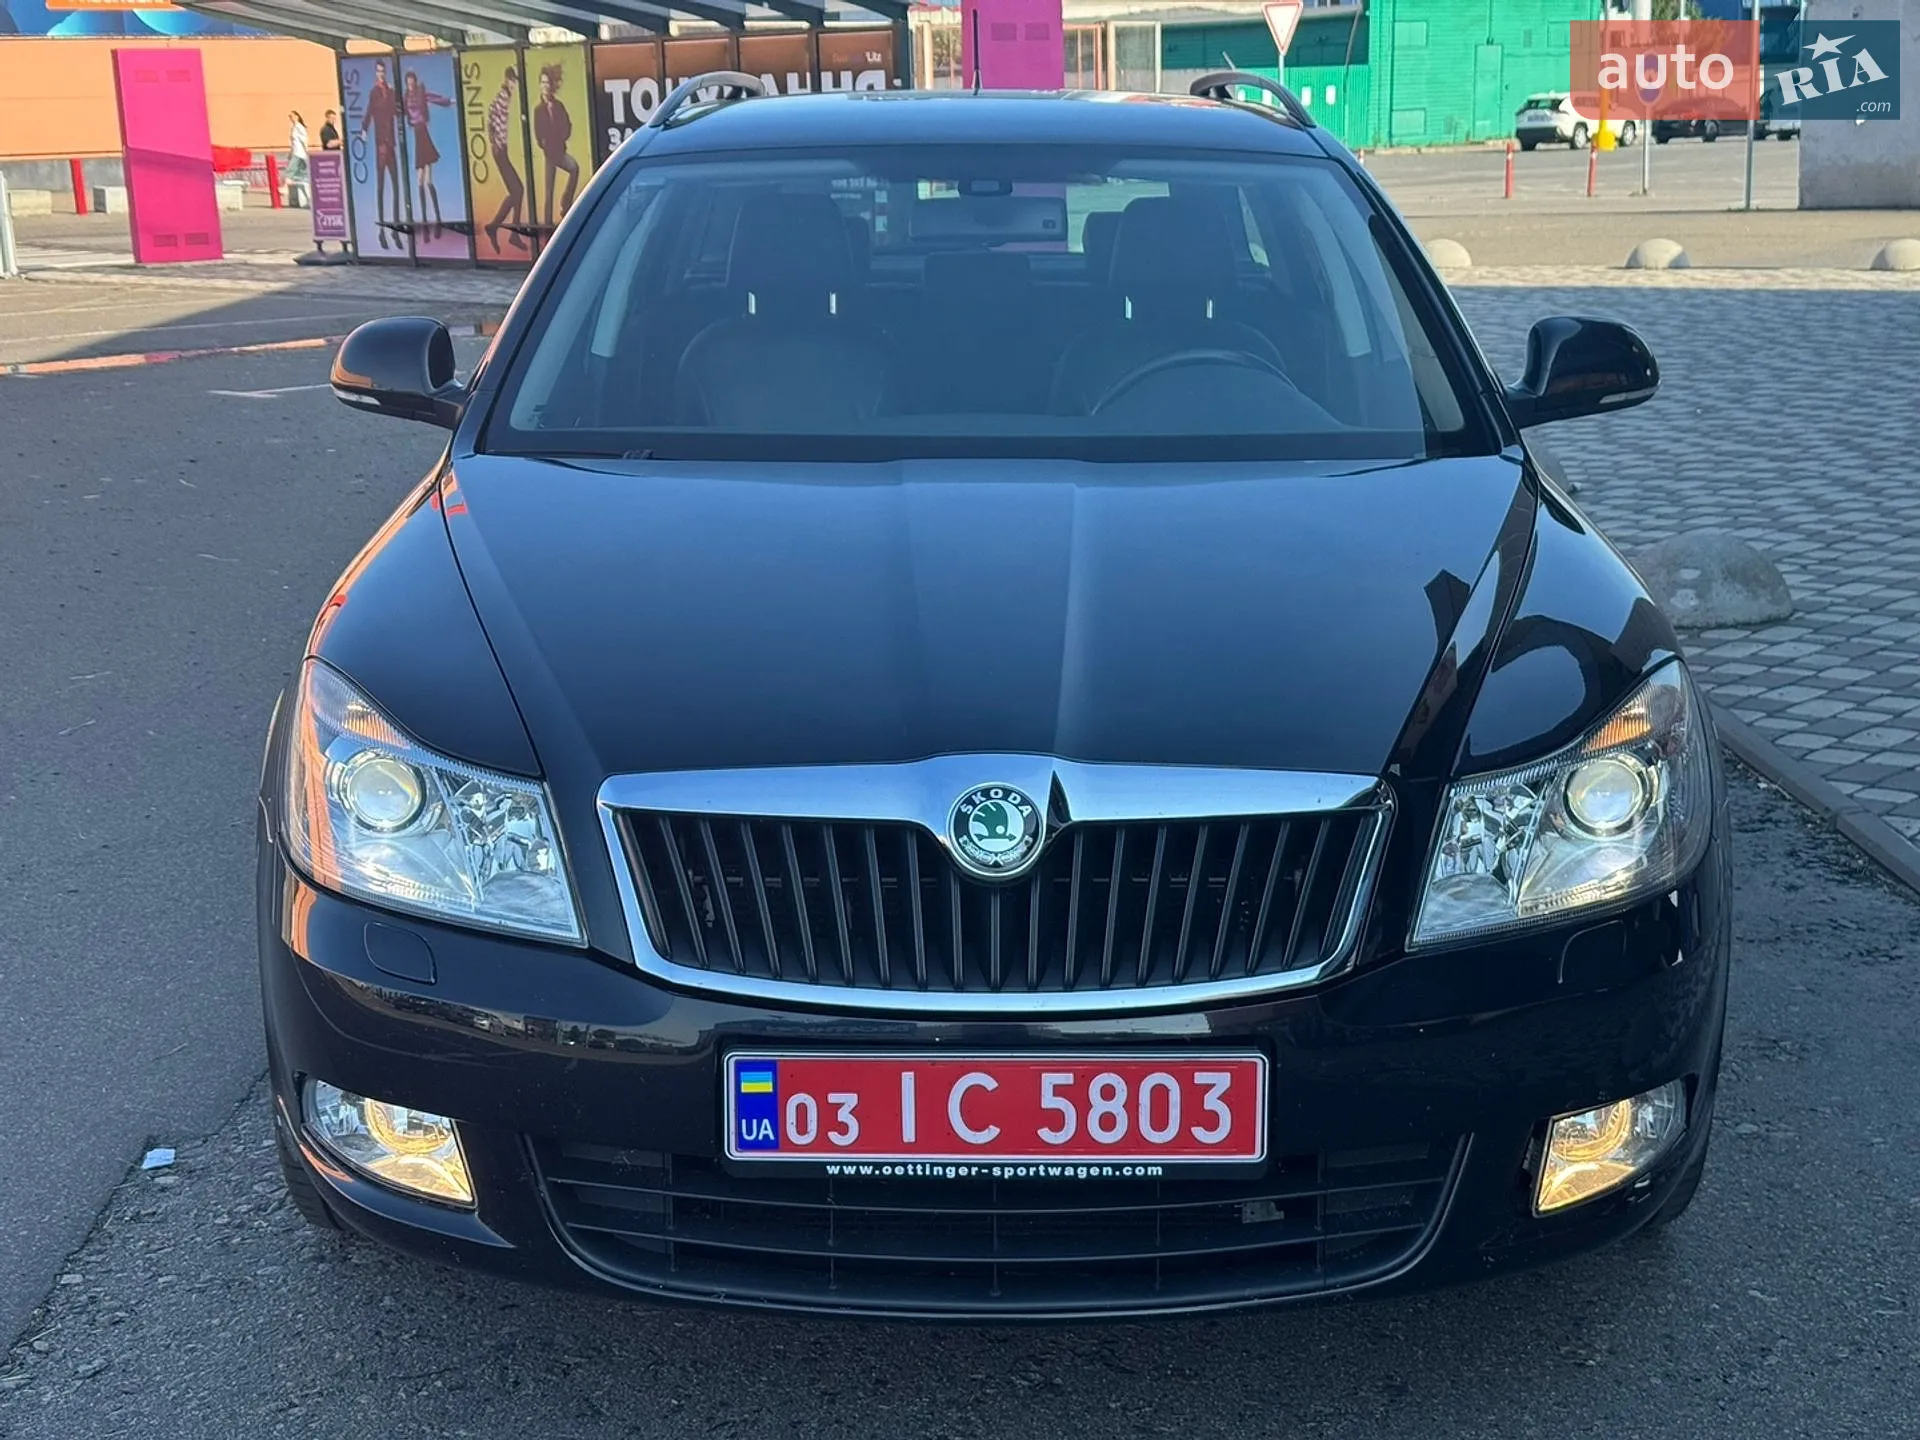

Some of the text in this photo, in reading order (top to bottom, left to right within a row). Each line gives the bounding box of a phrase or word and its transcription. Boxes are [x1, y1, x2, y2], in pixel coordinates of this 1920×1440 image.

[344, 69, 368, 184] COLIN'S
[463, 62, 489, 184] COLIN'S
[960, 788, 1033, 817] SKODA
[742, 1119, 775, 1141] UA
[785, 1093, 860, 1146] 03
[1037, 1071, 1233, 1146] 5803
[826, 1163, 1164, 1179] www.oettinger-sportwagen.com
